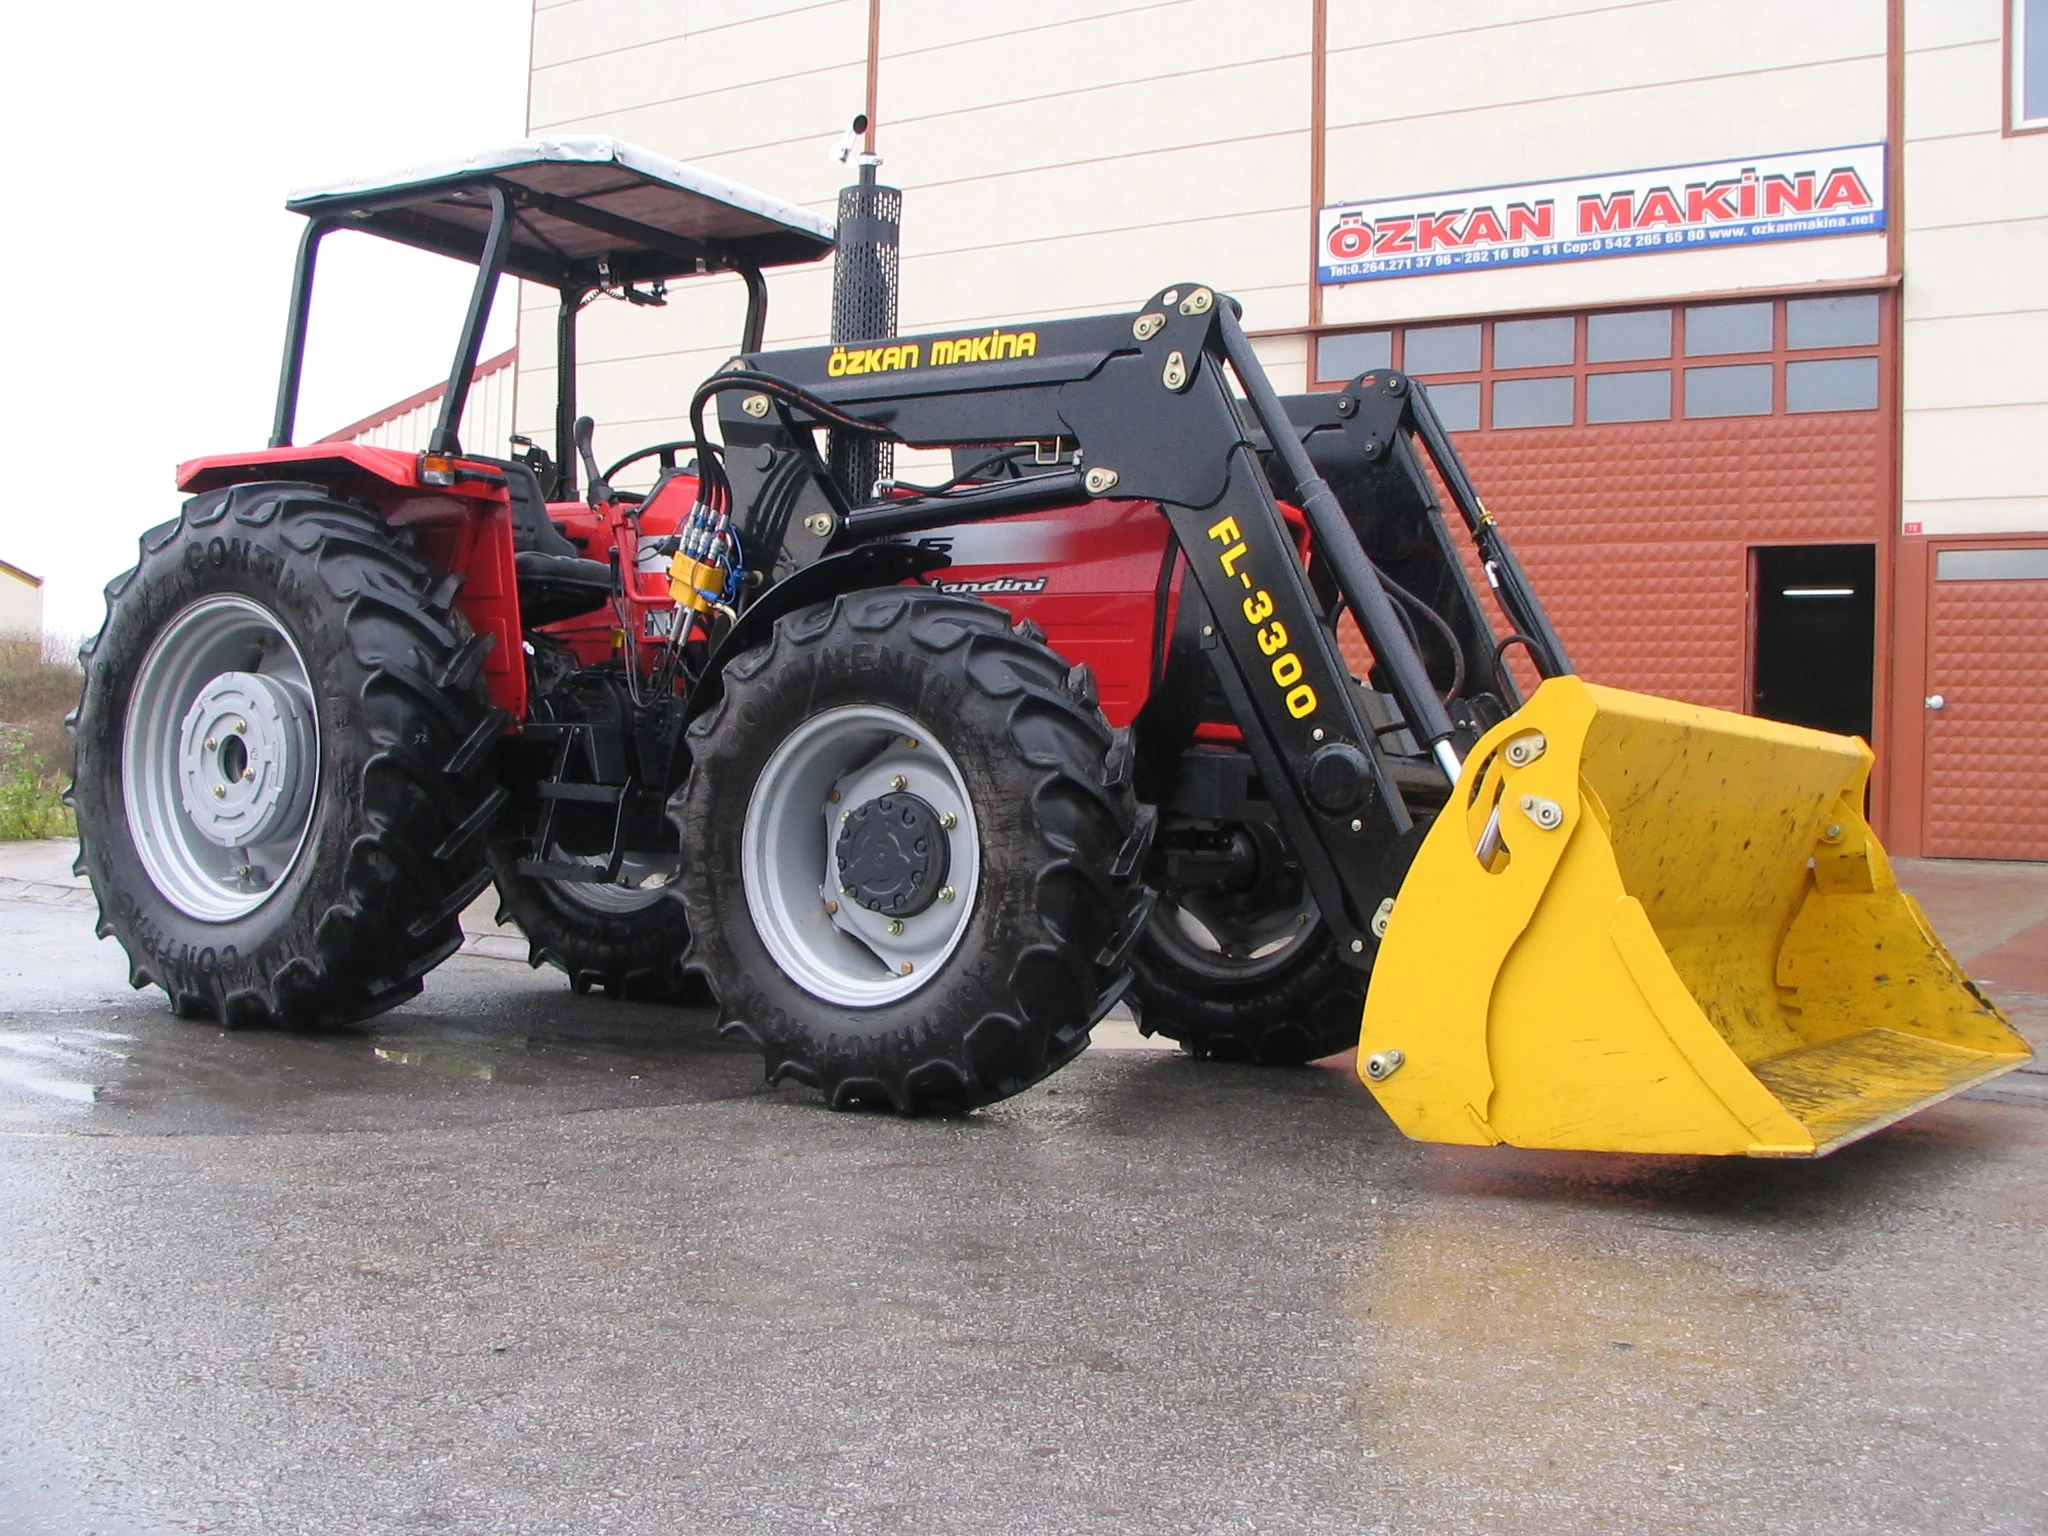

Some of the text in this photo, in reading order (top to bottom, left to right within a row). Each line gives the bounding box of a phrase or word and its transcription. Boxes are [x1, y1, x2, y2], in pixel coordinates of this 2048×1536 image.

[1327, 166, 1874, 261] ÖZKAN MAKİNA
[1415, 256, 1431, 268] 37
[1436, 254, 1451, 266] 96
[1464, 251, 1489, 264] 282
[1493, 249, 1507, 261] 16
[1605, 237, 1632, 250] 542
[1635, 233, 1661, 247] 265
[1665, 231, 1682, 244] 65
[1687, 229, 1705, 242] 80
[827, 329, 1038, 378] ÖZKAN MAKİNA
[1207, 515, 1319, 720] FL-3300
